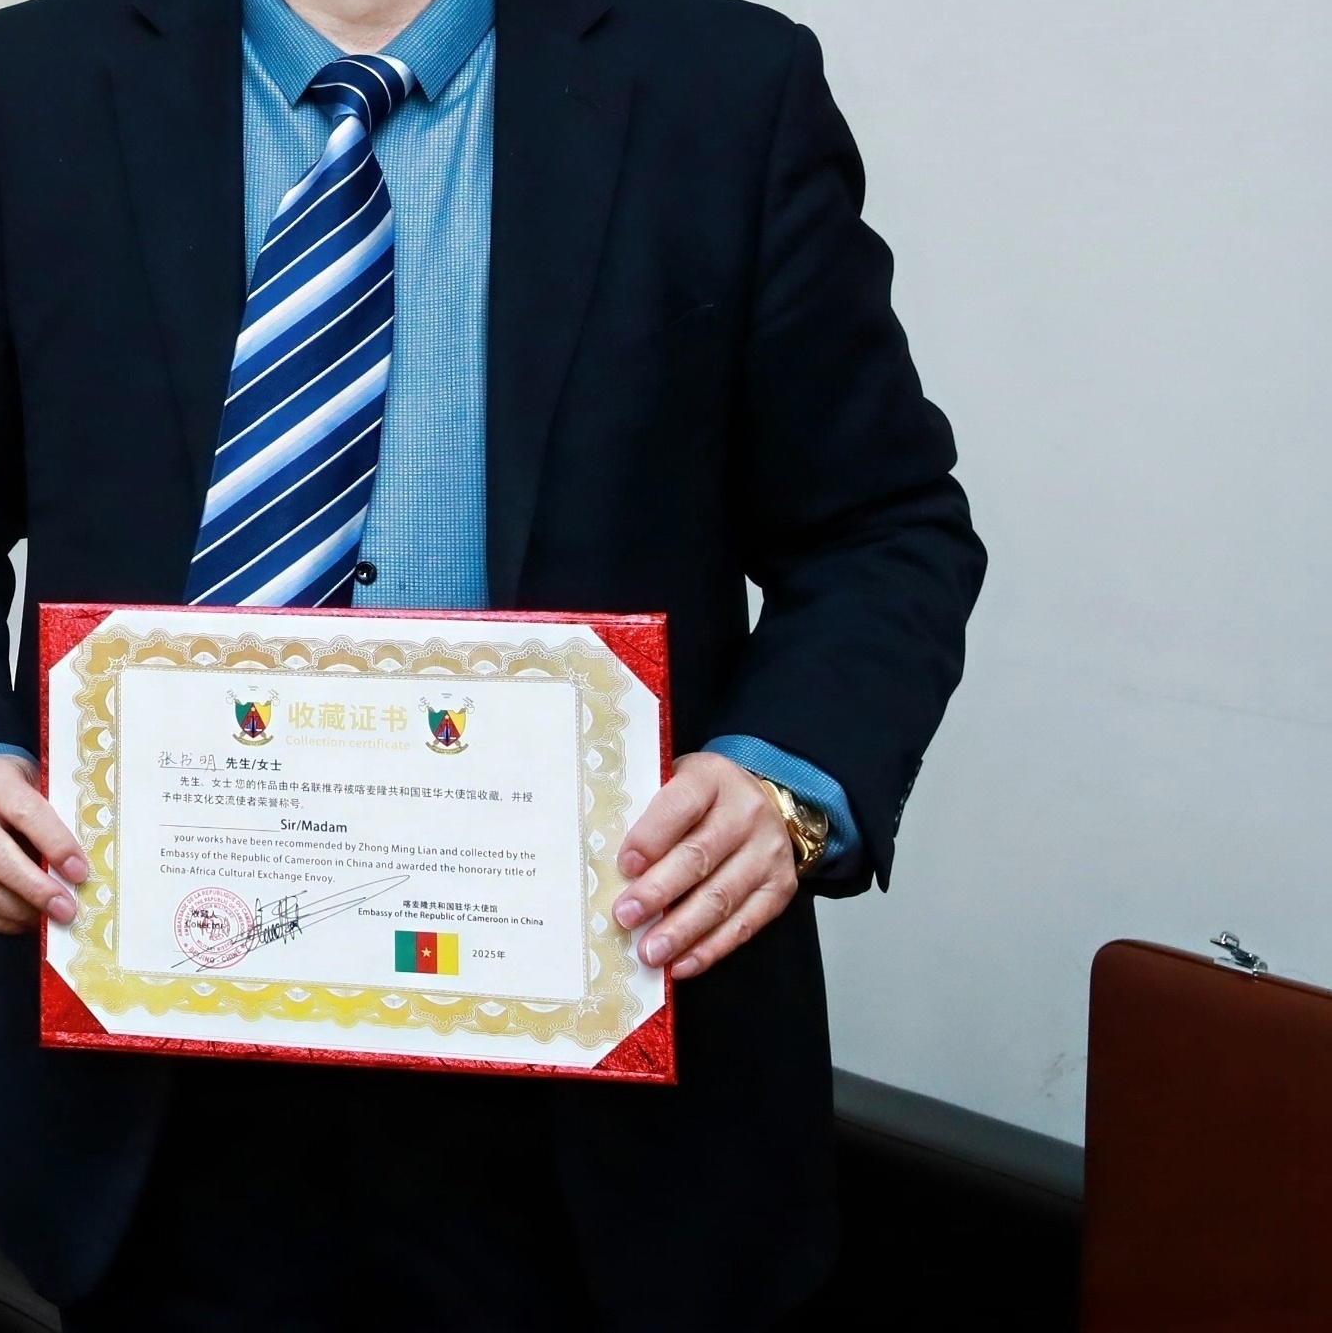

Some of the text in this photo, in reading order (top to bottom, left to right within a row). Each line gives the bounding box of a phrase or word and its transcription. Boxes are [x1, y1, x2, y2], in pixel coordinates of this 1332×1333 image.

[288, 701, 409, 733] 收藏证书
[285, 735, 346, 748] Collection
[348, 737, 411, 751] certificate
[226, 757, 282, 771] 先生/女士
[280, 818, 348, 834] Sir/Madam
[174, 835, 536, 861] your works have been recommended by Zhong Ming Lian and collected by the
[160, 848, 537, 877] Embassy of the Republic of Cameroon in China and awarded the honorary title of
[160, 864, 336, 885] China-Africa Cultural Exchange Envoy.
[402, 900, 498, 913] 喀麦隆共和国驻华大使馆
[358, 907, 544, 926] Embassy of the Republic of Cameroon in China
[472, 949, 506, 959] 2025年
